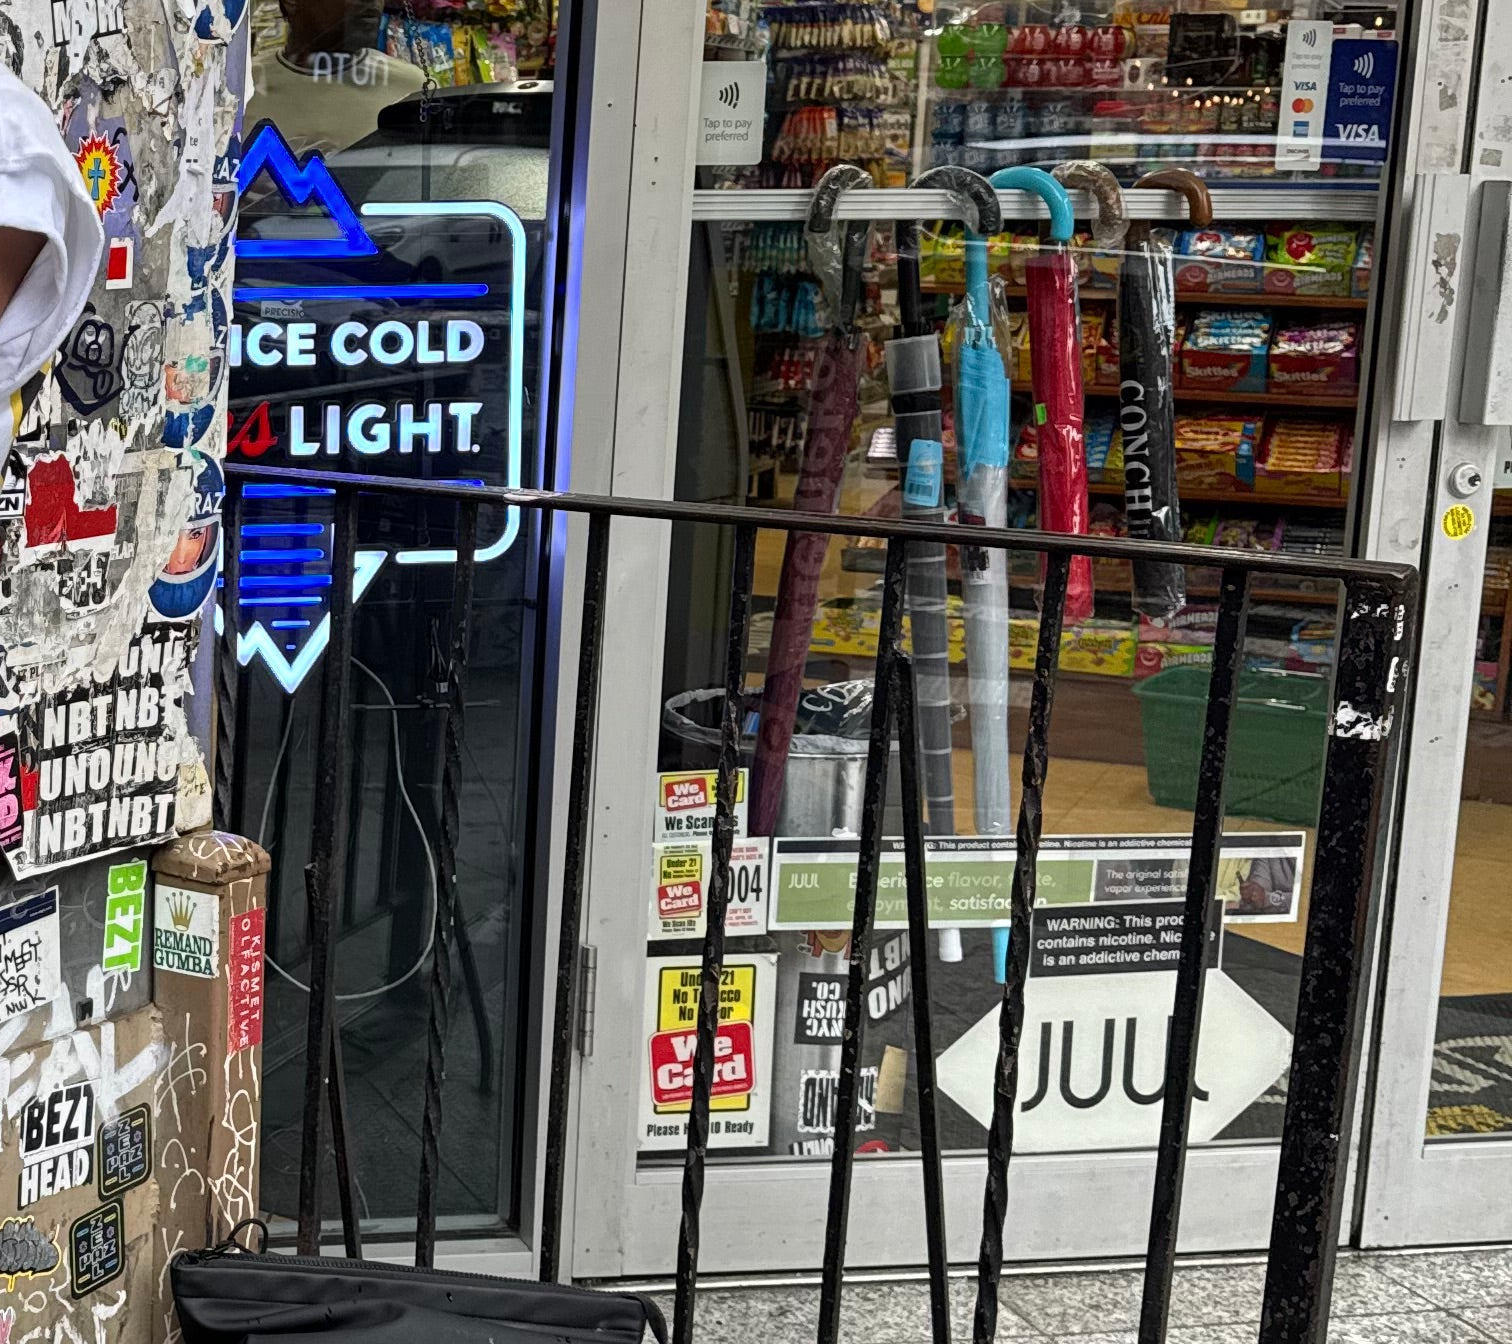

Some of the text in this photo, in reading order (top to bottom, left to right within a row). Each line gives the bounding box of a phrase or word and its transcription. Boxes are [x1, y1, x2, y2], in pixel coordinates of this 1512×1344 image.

[1294, 81, 1318, 92] VISA
[1339, 82, 1385, 100] Tap to pay
[1339, 94, 1381, 109] preferred
[703, 116, 753, 134] Tap to pay
[1336, 124, 1381, 142] VISA
[704, 129, 749, 144] preferred
[229, 319, 485, 367] ICE COLD
[672, 783, 700, 796] We
[667, 792, 706, 808] Card
[109, 793, 173, 838] NBT
[665, 816, 683, 831] We
[788, 872, 820, 889] JUUL
[1105, 868, 1162, 882] The original
[666, 885, 693, 897] We
[1104, 884, 1132, 896] vapor
[660, 895, 699, 911] Card
[1046, 914, 1153, 932] WARNING: This
[155, 928, 213, 957] REMAND
[1037, 932, 1157, 950] contains nicotine.
[154, 947, 215, 976] GUMBA
[1042, 949, 1141, 967] is an addictive
[249, 935, 261, 1021] KISMET
[673, 988, 689, 1004] No
[679, 1007, 694, 1022] No
[646, 1123, 680, 1137] Please
[724, 1120, 755, 1136] Ready
[21, 1147, 92, 1205] HEAD
